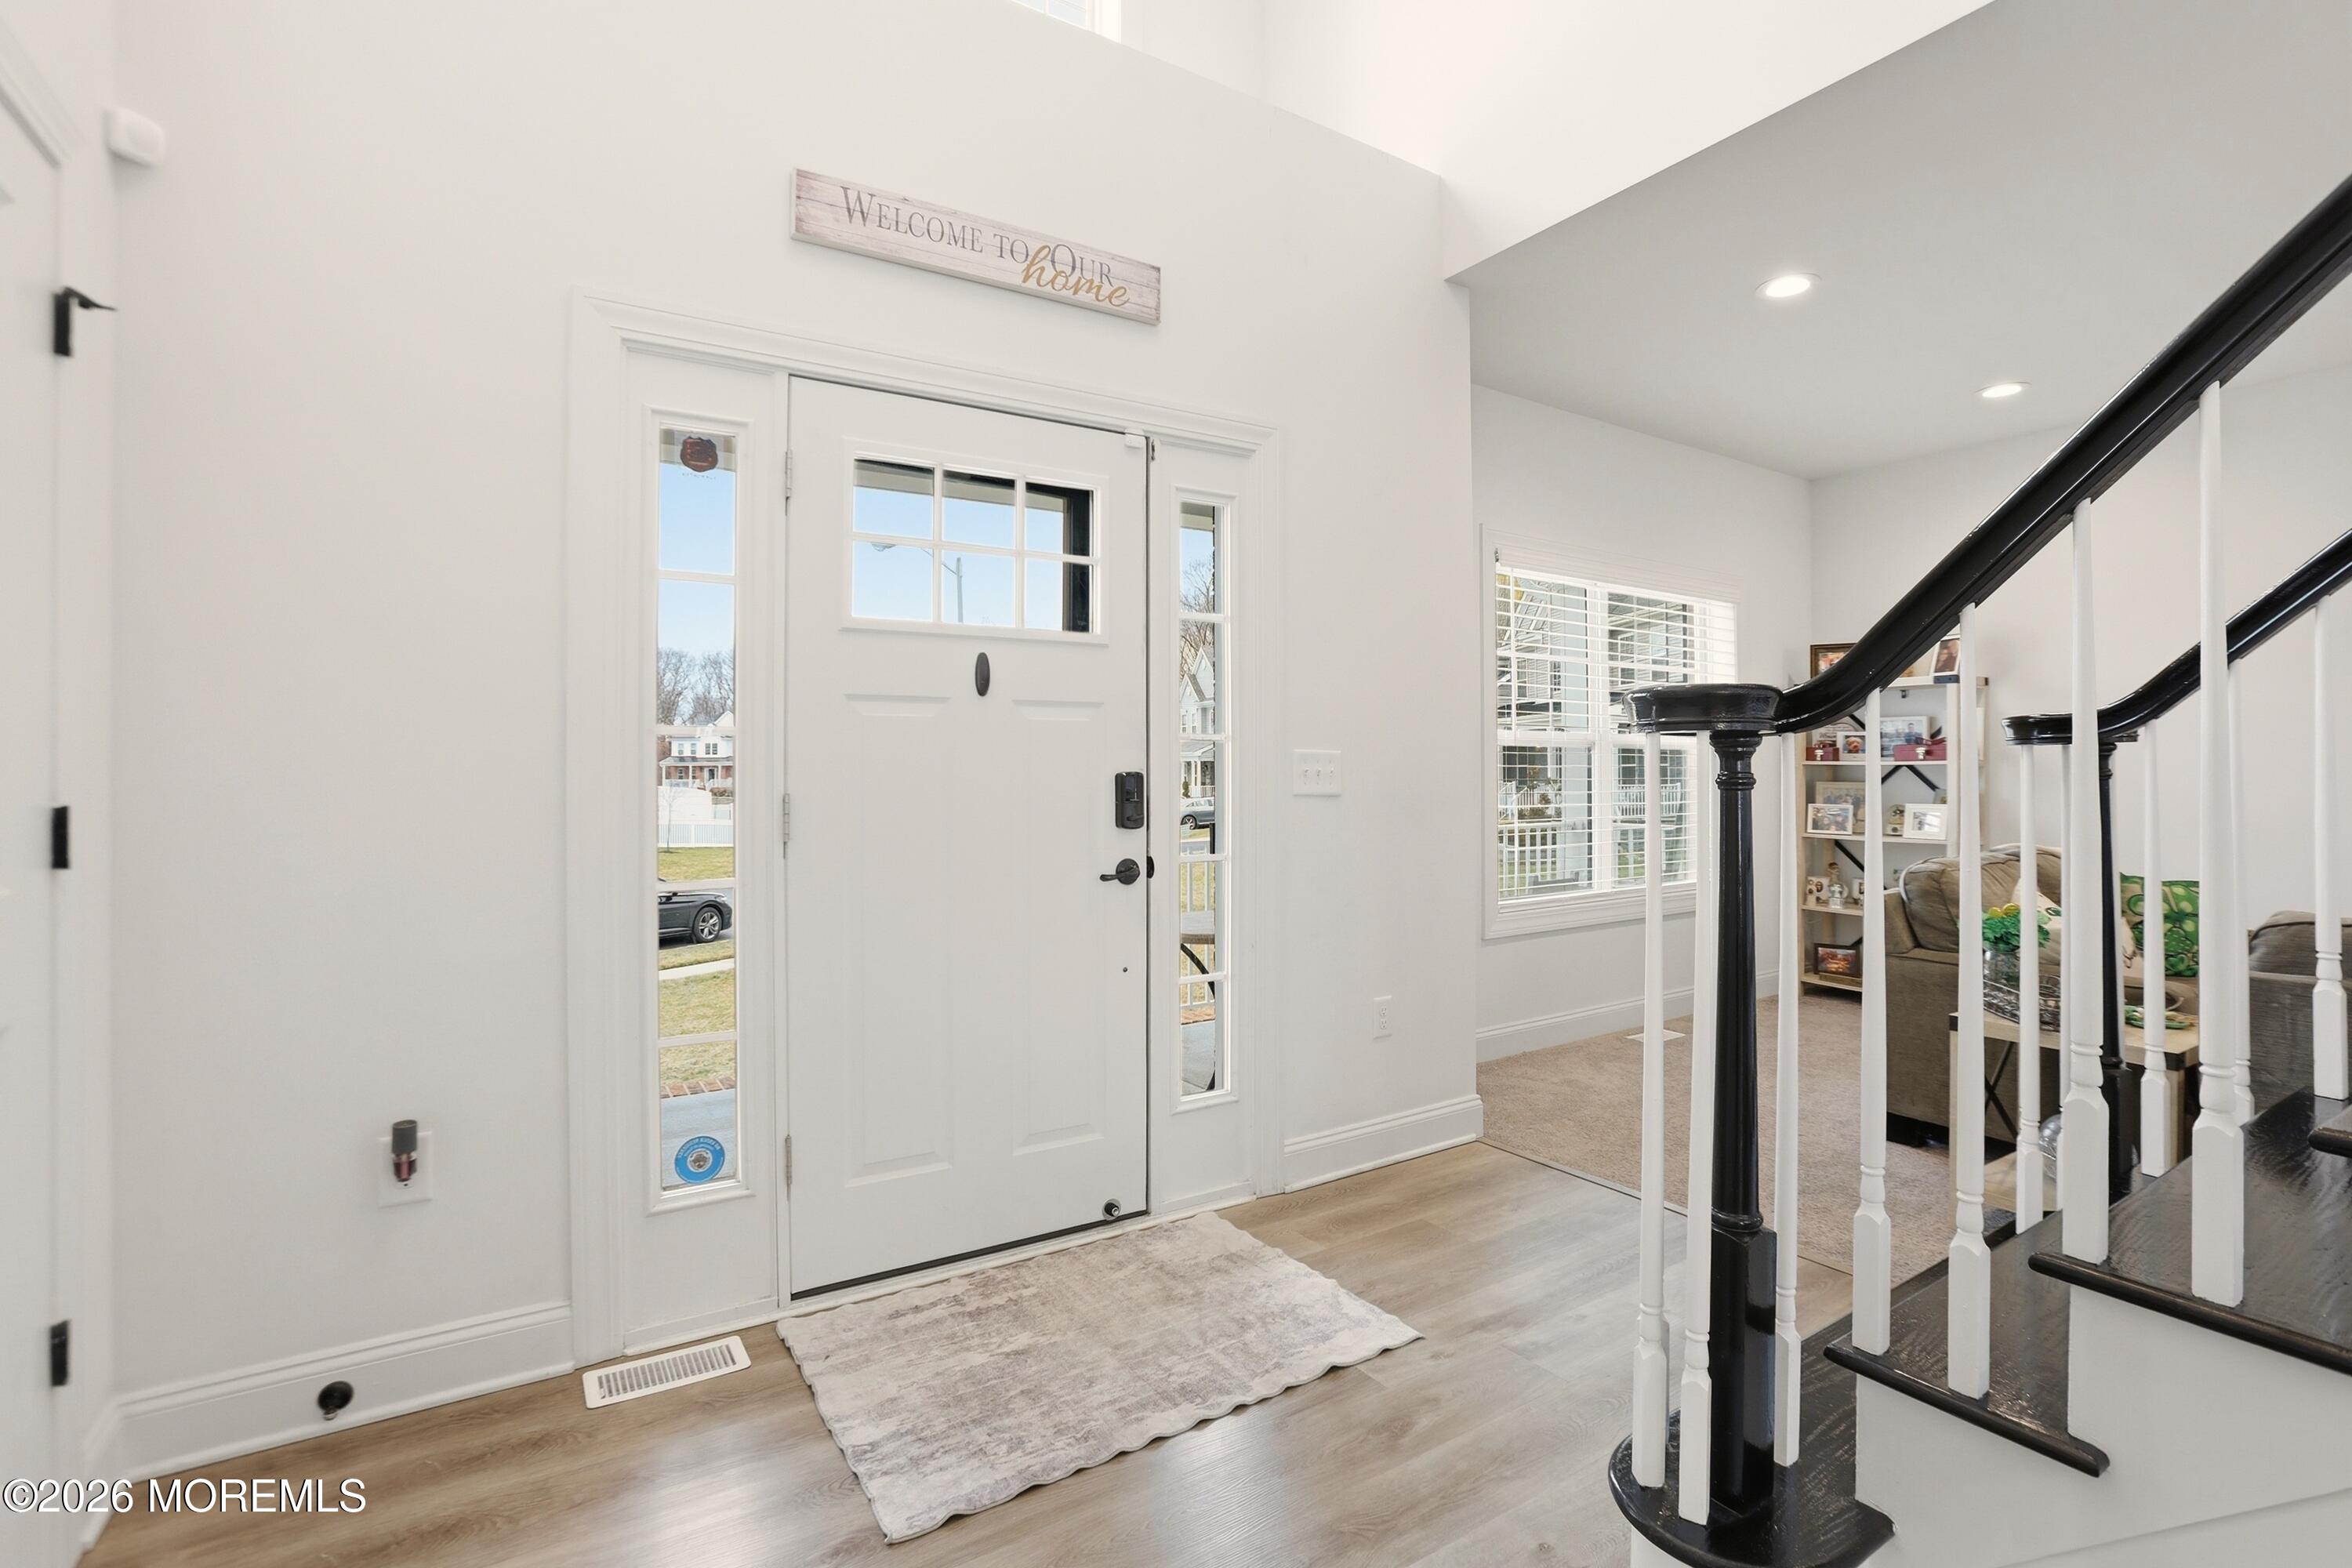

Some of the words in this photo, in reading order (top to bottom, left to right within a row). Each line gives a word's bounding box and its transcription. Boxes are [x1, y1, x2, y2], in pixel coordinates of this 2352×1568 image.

[840, 186, 983, 253] WELCOME
[993, 233, 1029, 264] TO
[1051, 244, 1114, 287] OUR
[1022, 245, 1130, 307] home
